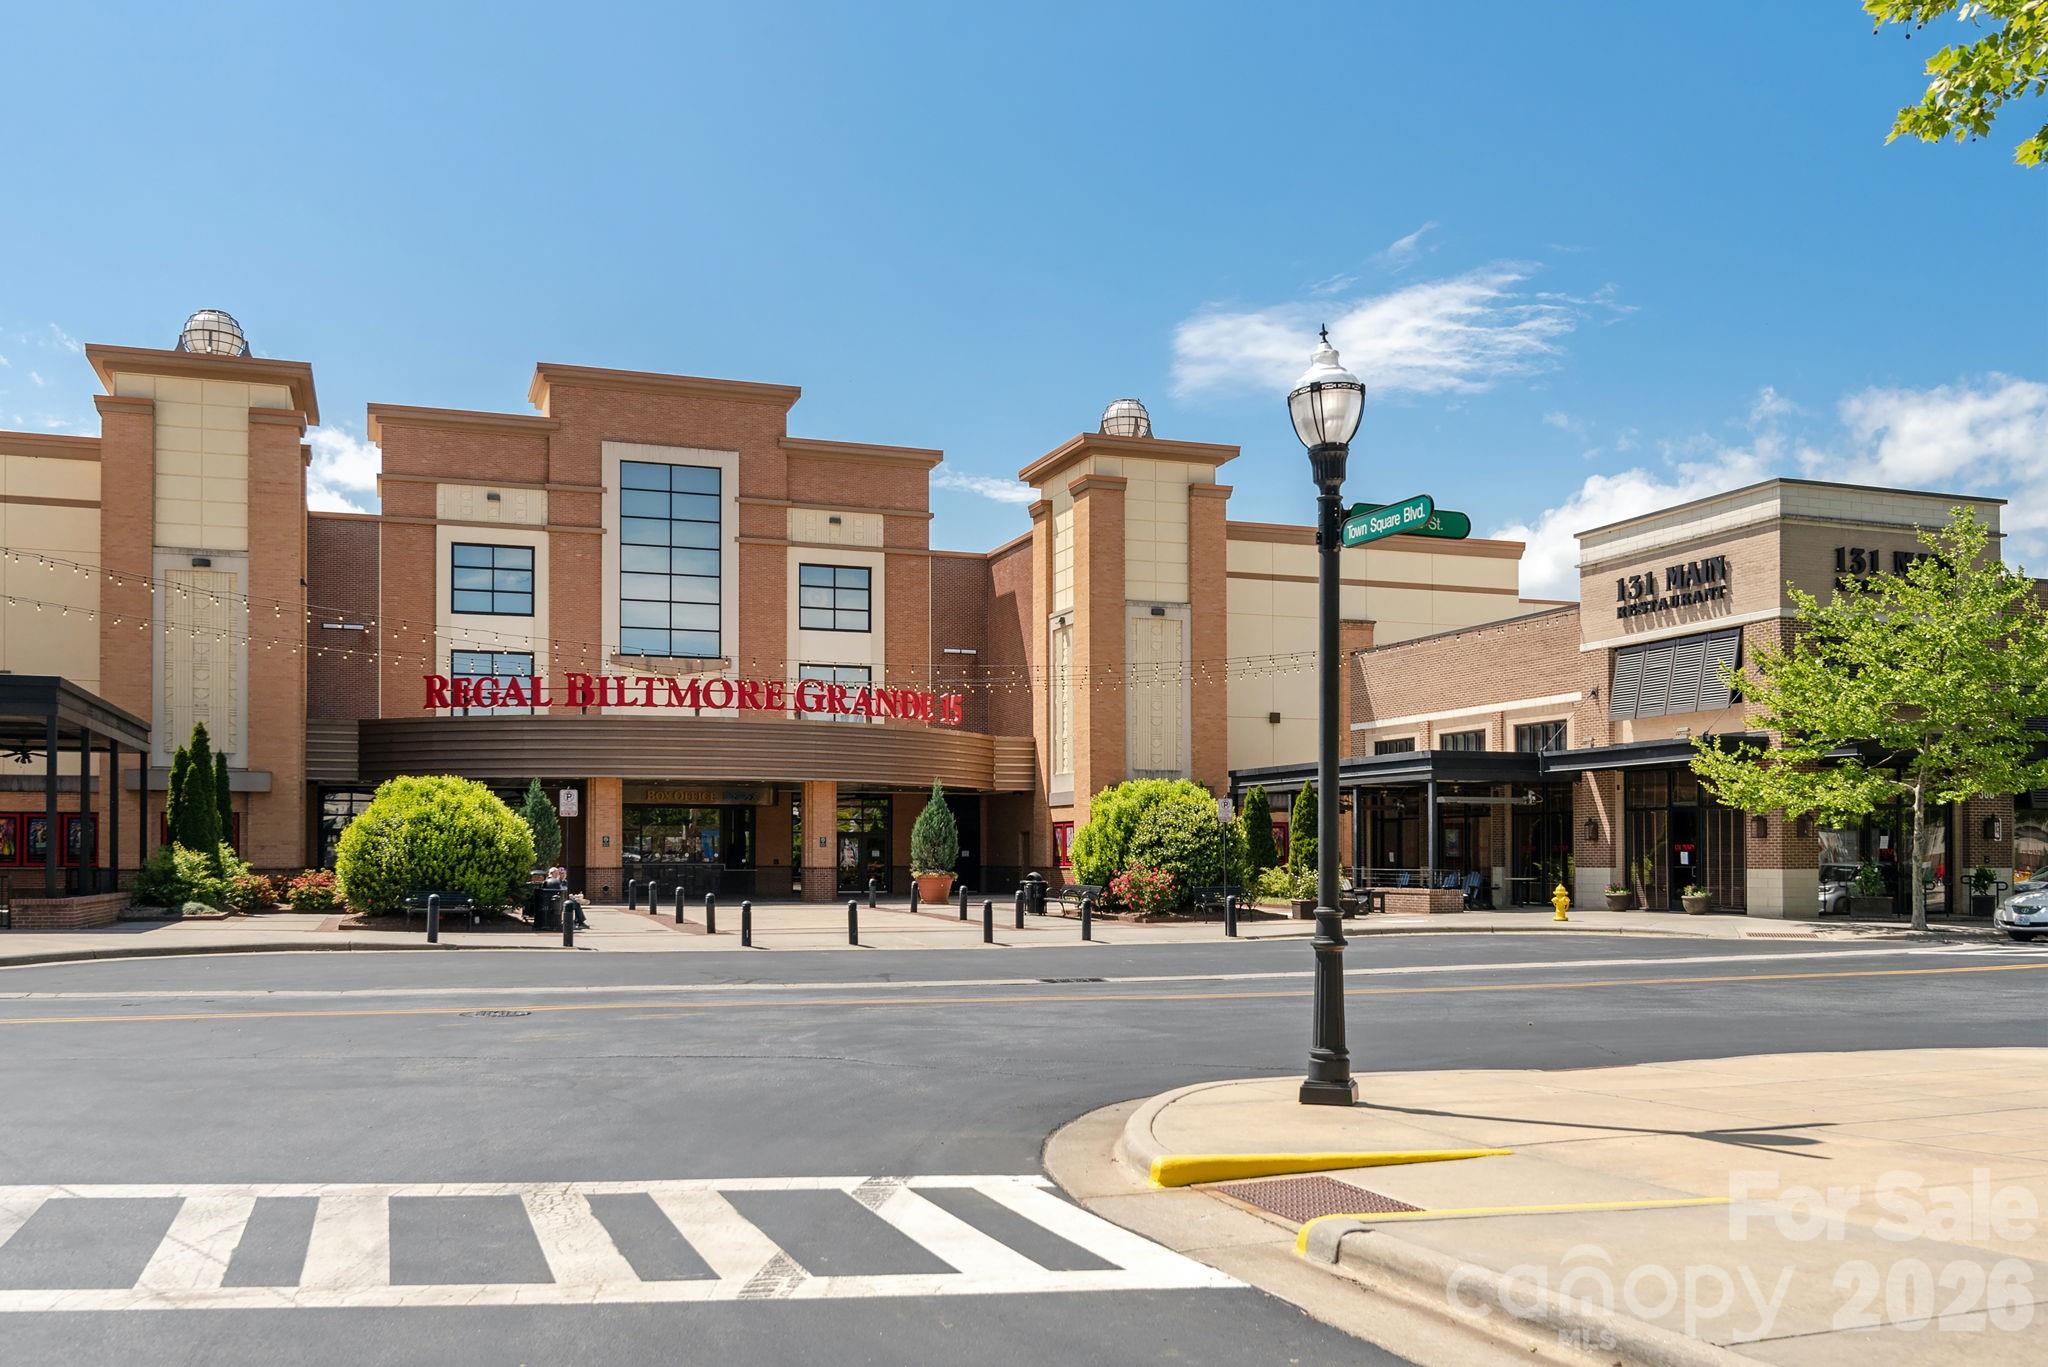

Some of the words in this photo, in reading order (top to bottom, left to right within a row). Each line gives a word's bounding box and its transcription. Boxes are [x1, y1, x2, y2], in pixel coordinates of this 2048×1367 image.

[1347, 524, 1367, 539] Town
[1370, 514, 1400, 533] Square
[1403, 503, 1425, 523] Blvd.
[1428, 516, 1443, 531] St.
[1616, 571, 1653, 602] 131
[1666, 555, 1726, 591] MAIN
[1835, 547, 1879, 576] 131
[1616, 585, 1727, 619] RESTAURANT
[423, 675, 554, 710] REGAL
[564, 672, 785, 711] BILTMORE
[795, 679, 936, 721] GRANDE
[940, 692, 964, 725] 15
[646, 790, 673, 801] BOX
[674, 790, 717, 801] OFFICE
